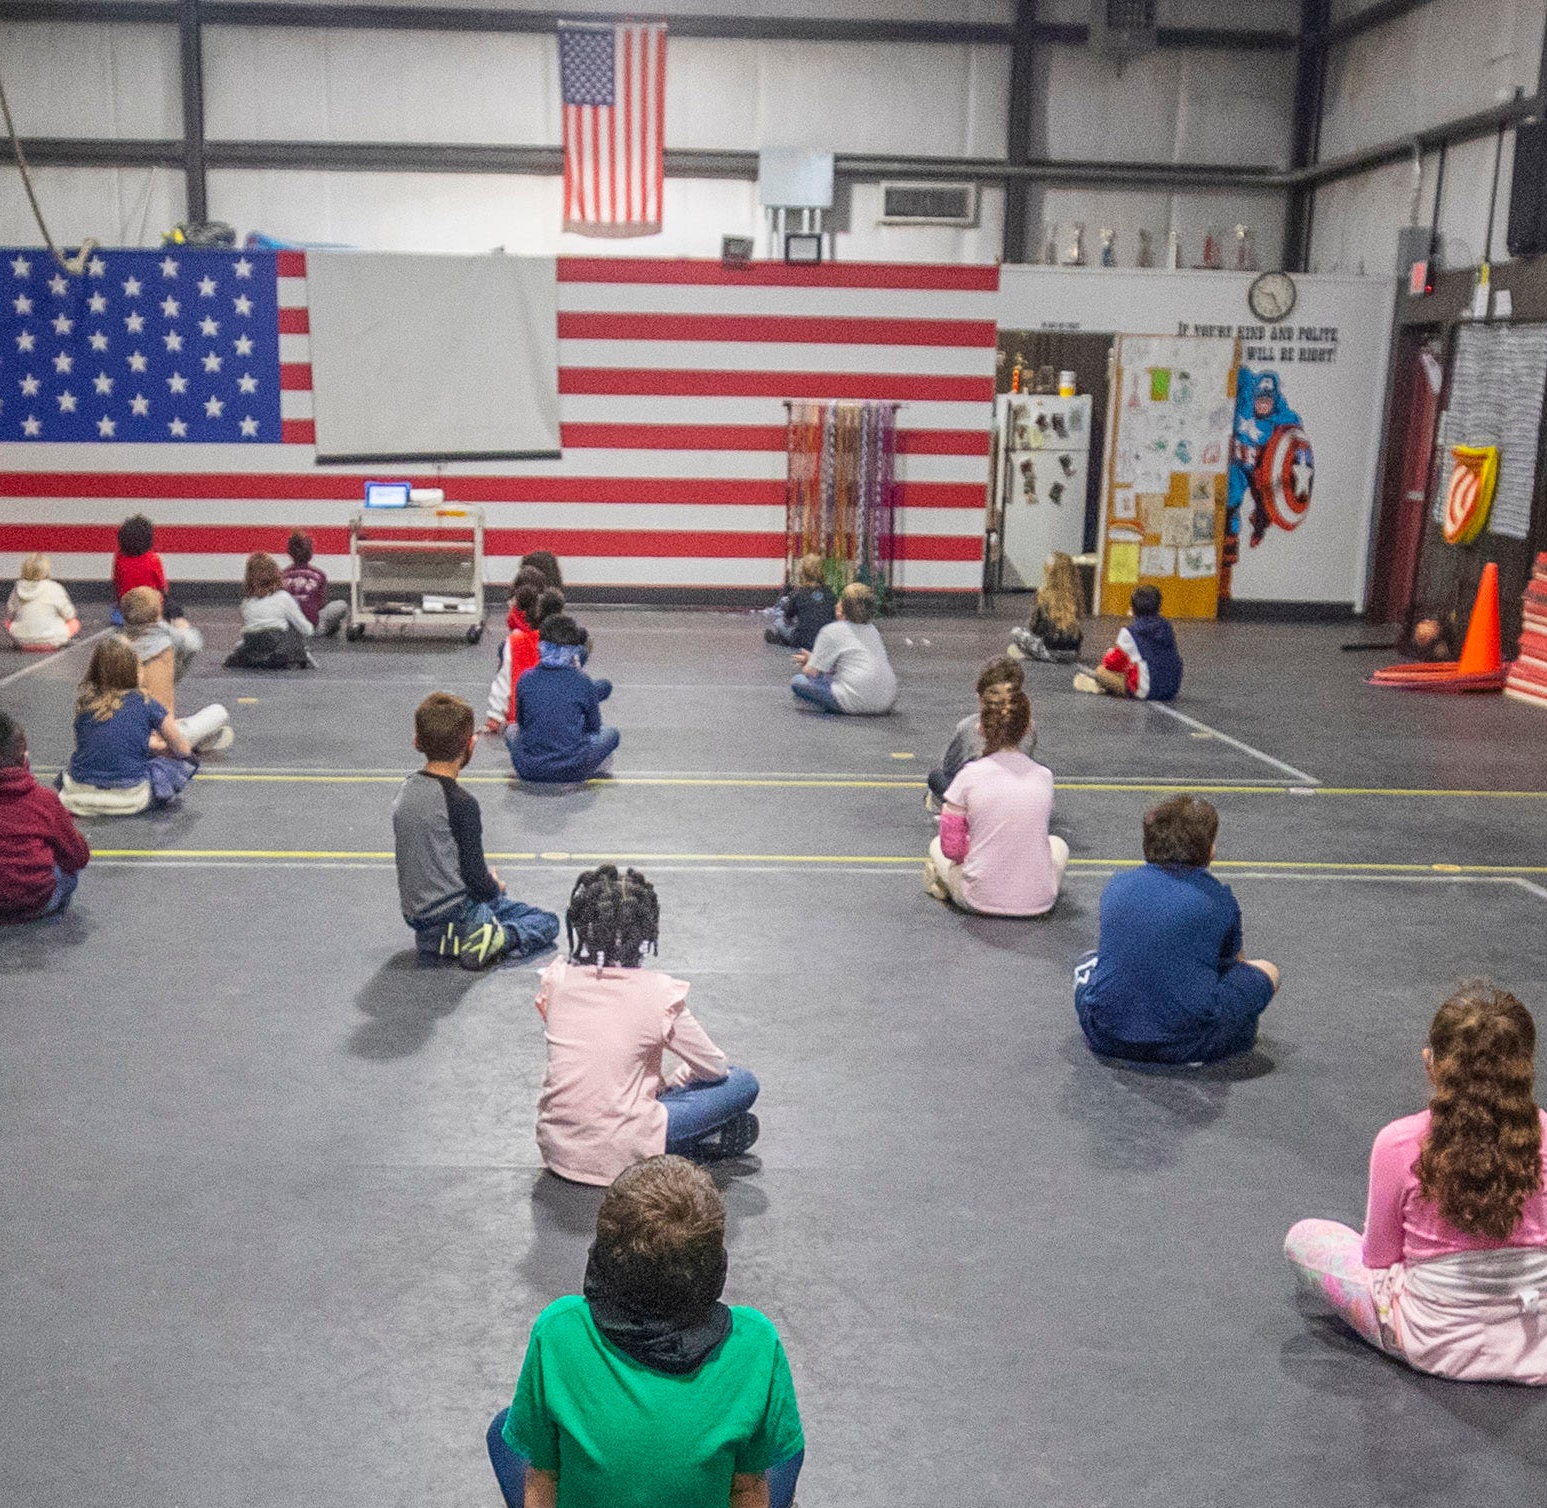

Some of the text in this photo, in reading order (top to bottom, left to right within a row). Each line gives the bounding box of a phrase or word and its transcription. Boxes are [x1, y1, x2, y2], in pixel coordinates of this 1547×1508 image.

[1270, 326, 1294, 341] AND
[1298, 327, 1338, 342] POLITE
[1247, 346, 1275, 361] WILL
[1280, 347, 1295, 362] BE
